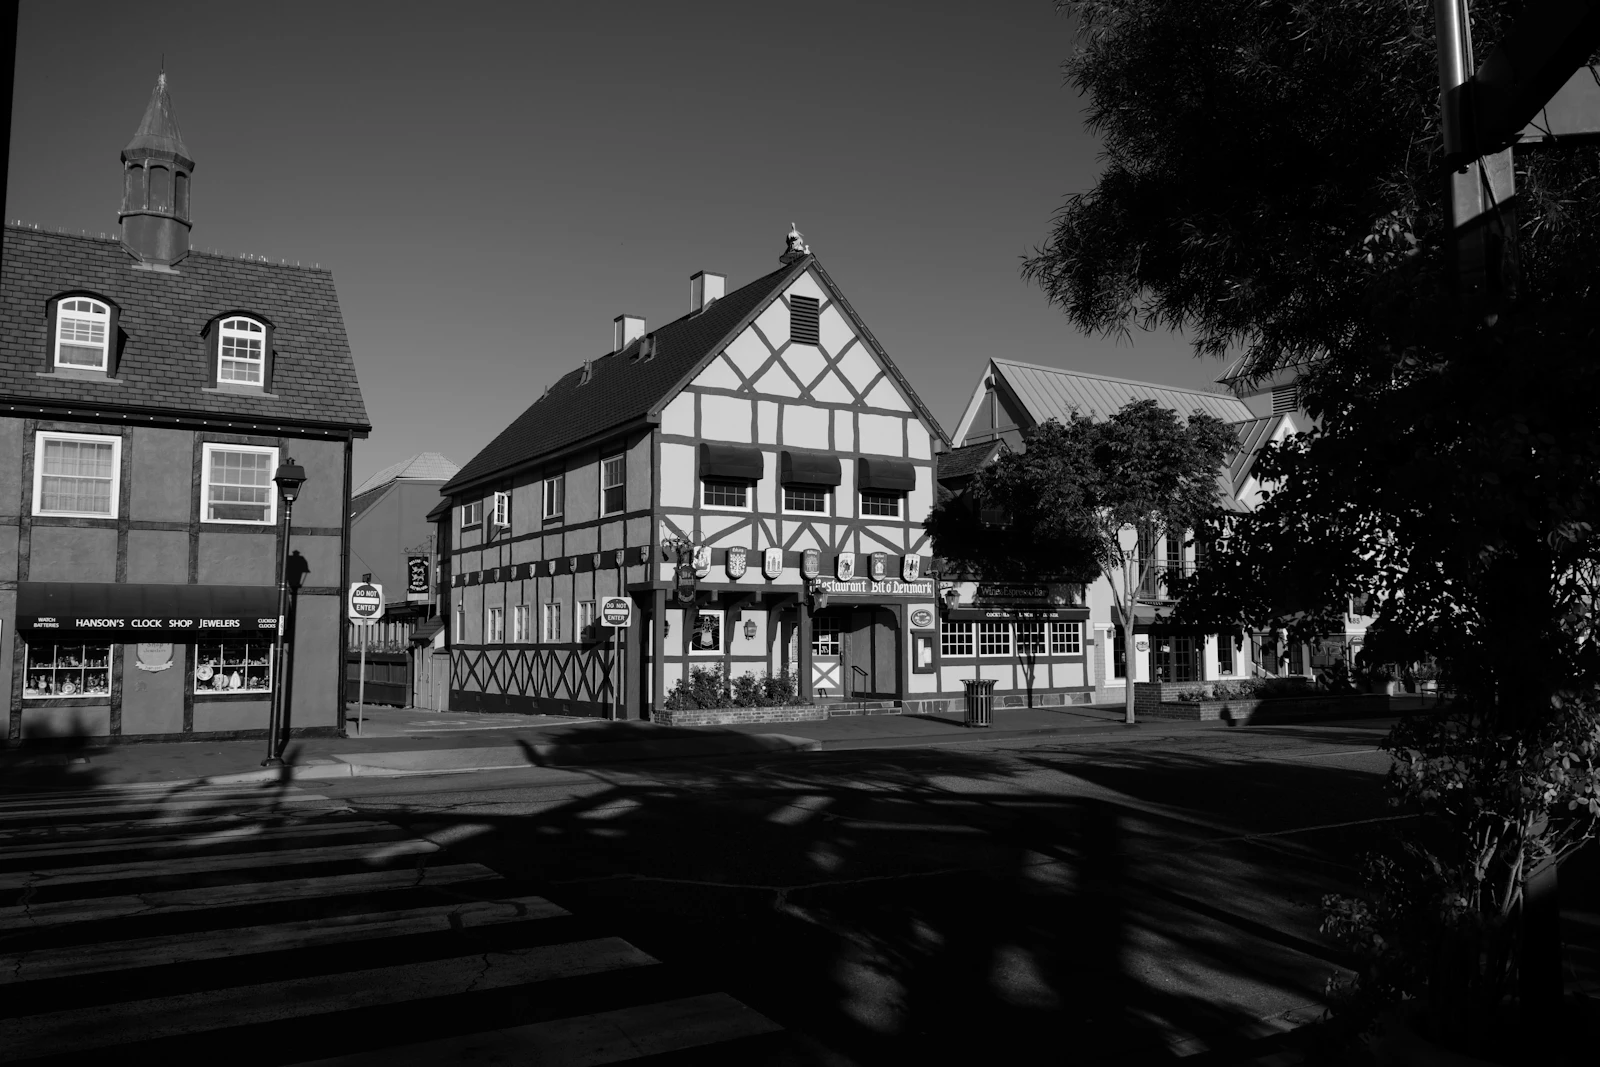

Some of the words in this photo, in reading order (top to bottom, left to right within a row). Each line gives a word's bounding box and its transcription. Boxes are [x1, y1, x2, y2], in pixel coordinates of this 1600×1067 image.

[871, 581, 886, 593] Bit
[892, 581, 932, 593] Denmark
[981, 585, 1000, 596] Wine
[1003, 587, 1034, 597] Espresso
[1034, 587, 1046, 597] Bar
[75, 619, 124, 627] HANSON'S
[131, 619, 162, 627] CLOCK
[168, 619, 193, 627] SHOP
[198, 619, 240, 628] JEWELERS
